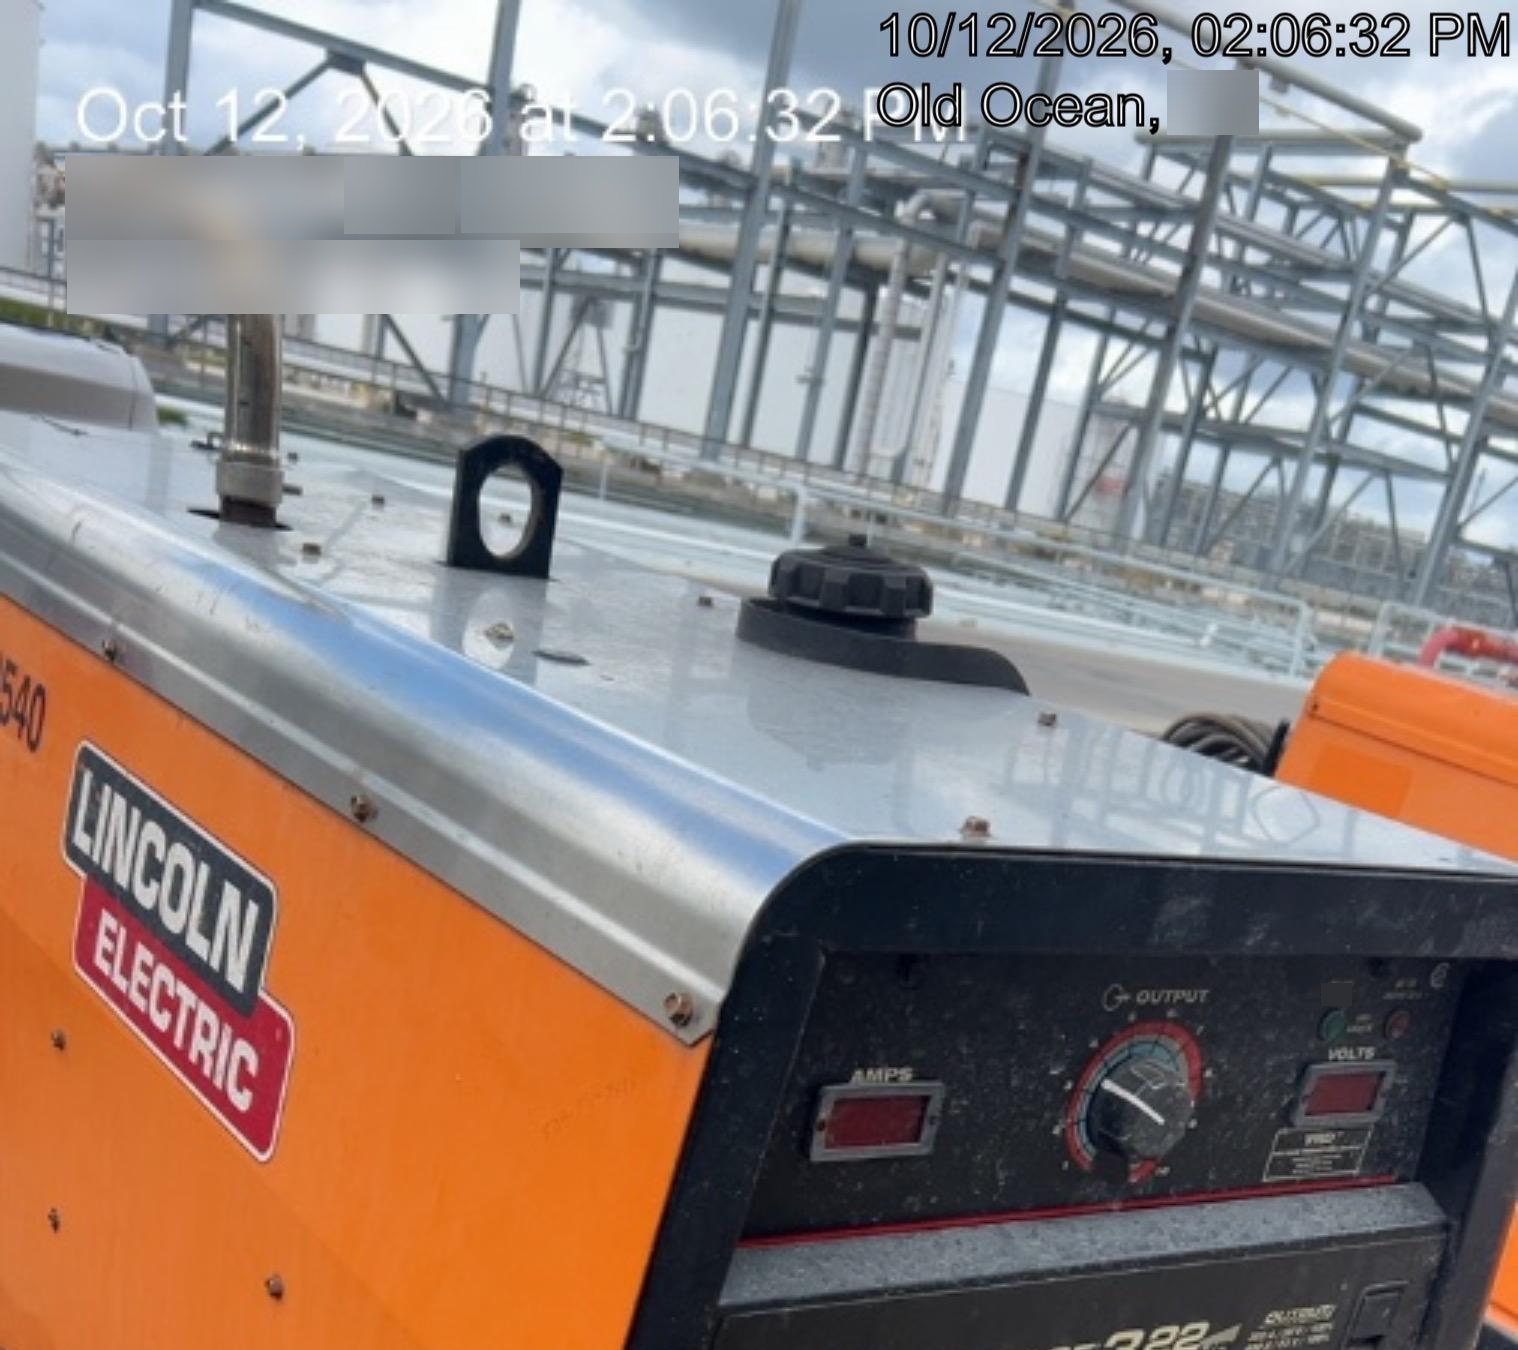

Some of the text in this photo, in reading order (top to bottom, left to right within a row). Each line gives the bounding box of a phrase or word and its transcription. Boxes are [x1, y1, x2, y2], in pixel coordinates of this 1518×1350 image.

[0, 656, 46, 753] 540
[72, 767, 260, 994] LINCOLN
[94, 908, 259, 1113] ELECTRIC
[1136, 988, 1210, 1004] OUTPUT
[850, 1067, 914, 1082] AMPS
[1328, 1046, 1376, 1061] VOLTS
